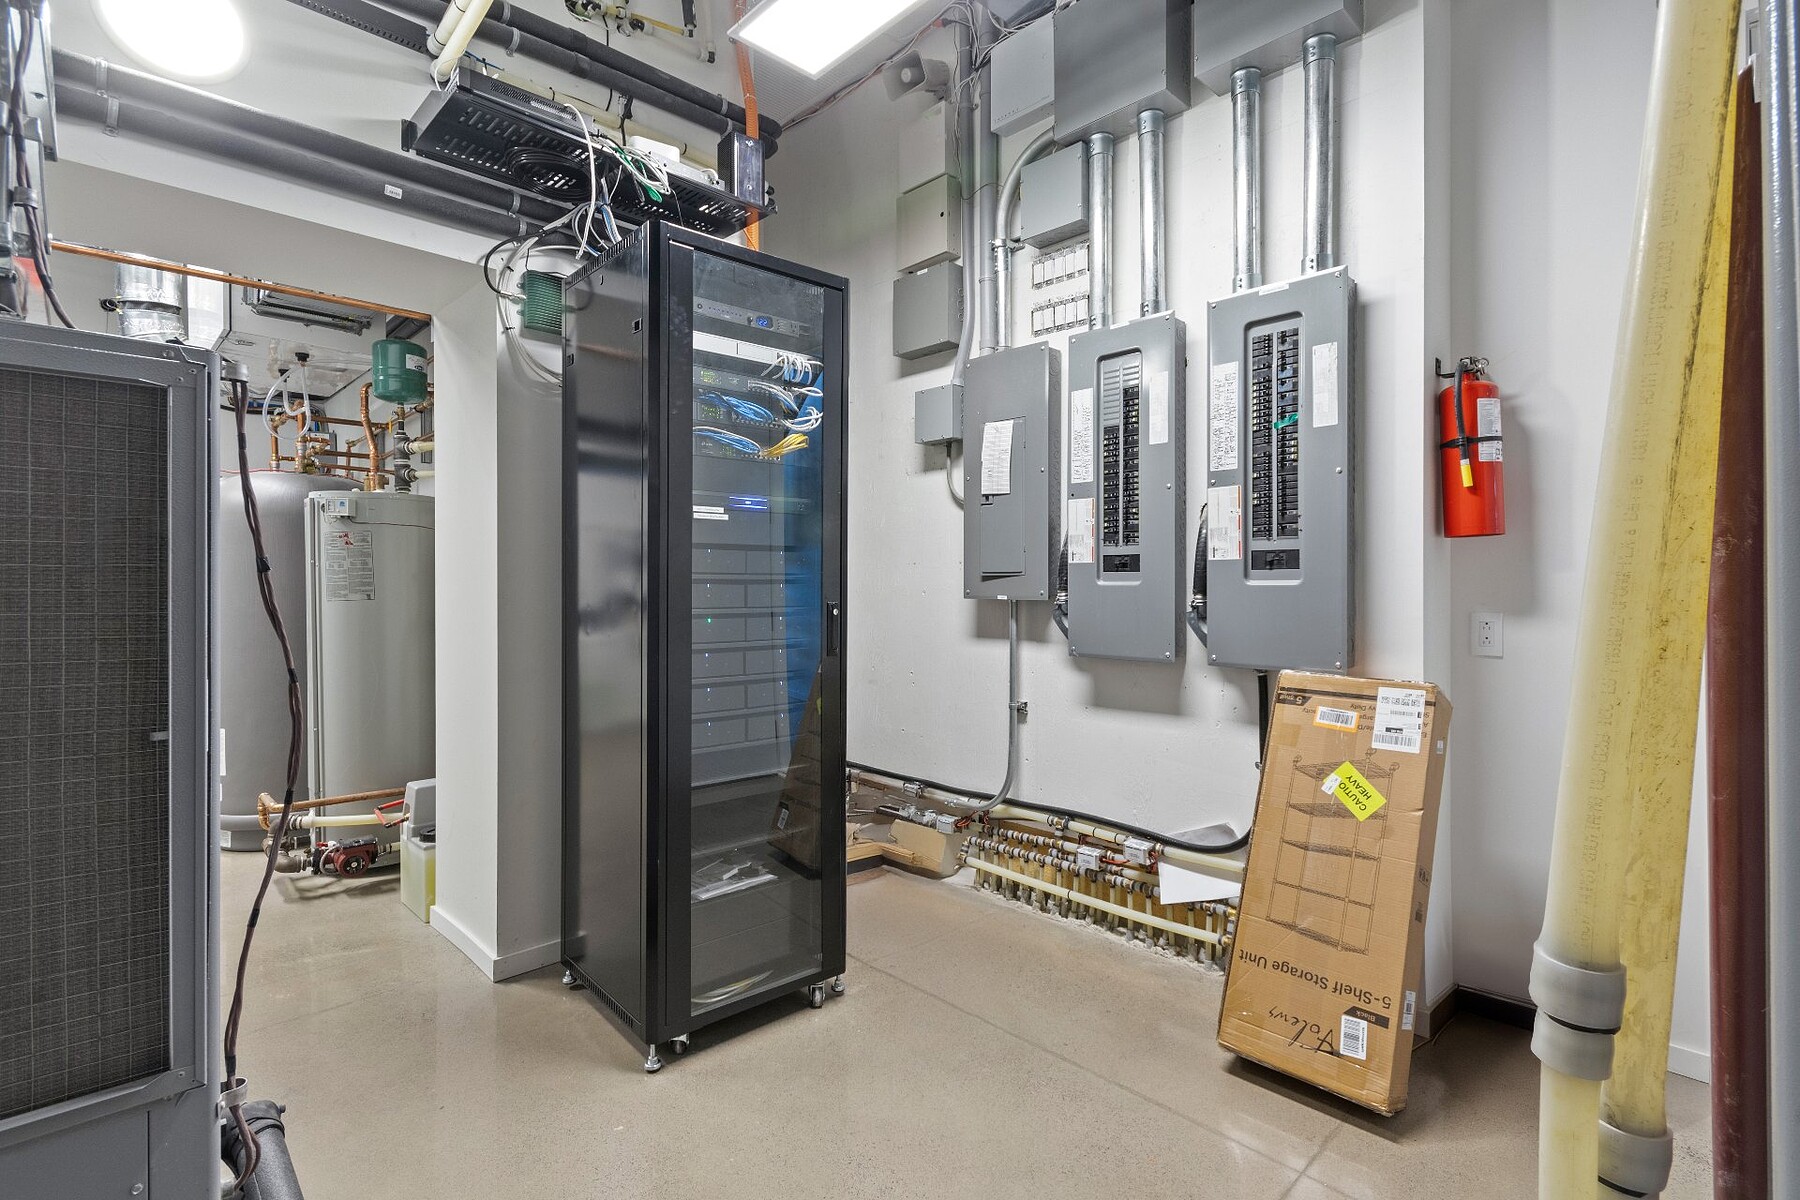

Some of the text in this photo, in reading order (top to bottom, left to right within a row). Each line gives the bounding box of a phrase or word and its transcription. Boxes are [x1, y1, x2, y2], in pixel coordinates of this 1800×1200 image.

[1338, 781, 1367, 811] CAUTIO
[1345, 774, 1372, 800] HEAVY
[1238, 949, 1392, 1009] 5-Shelf Storage Unit
[1355, 1010, 1376, 1022] Black
